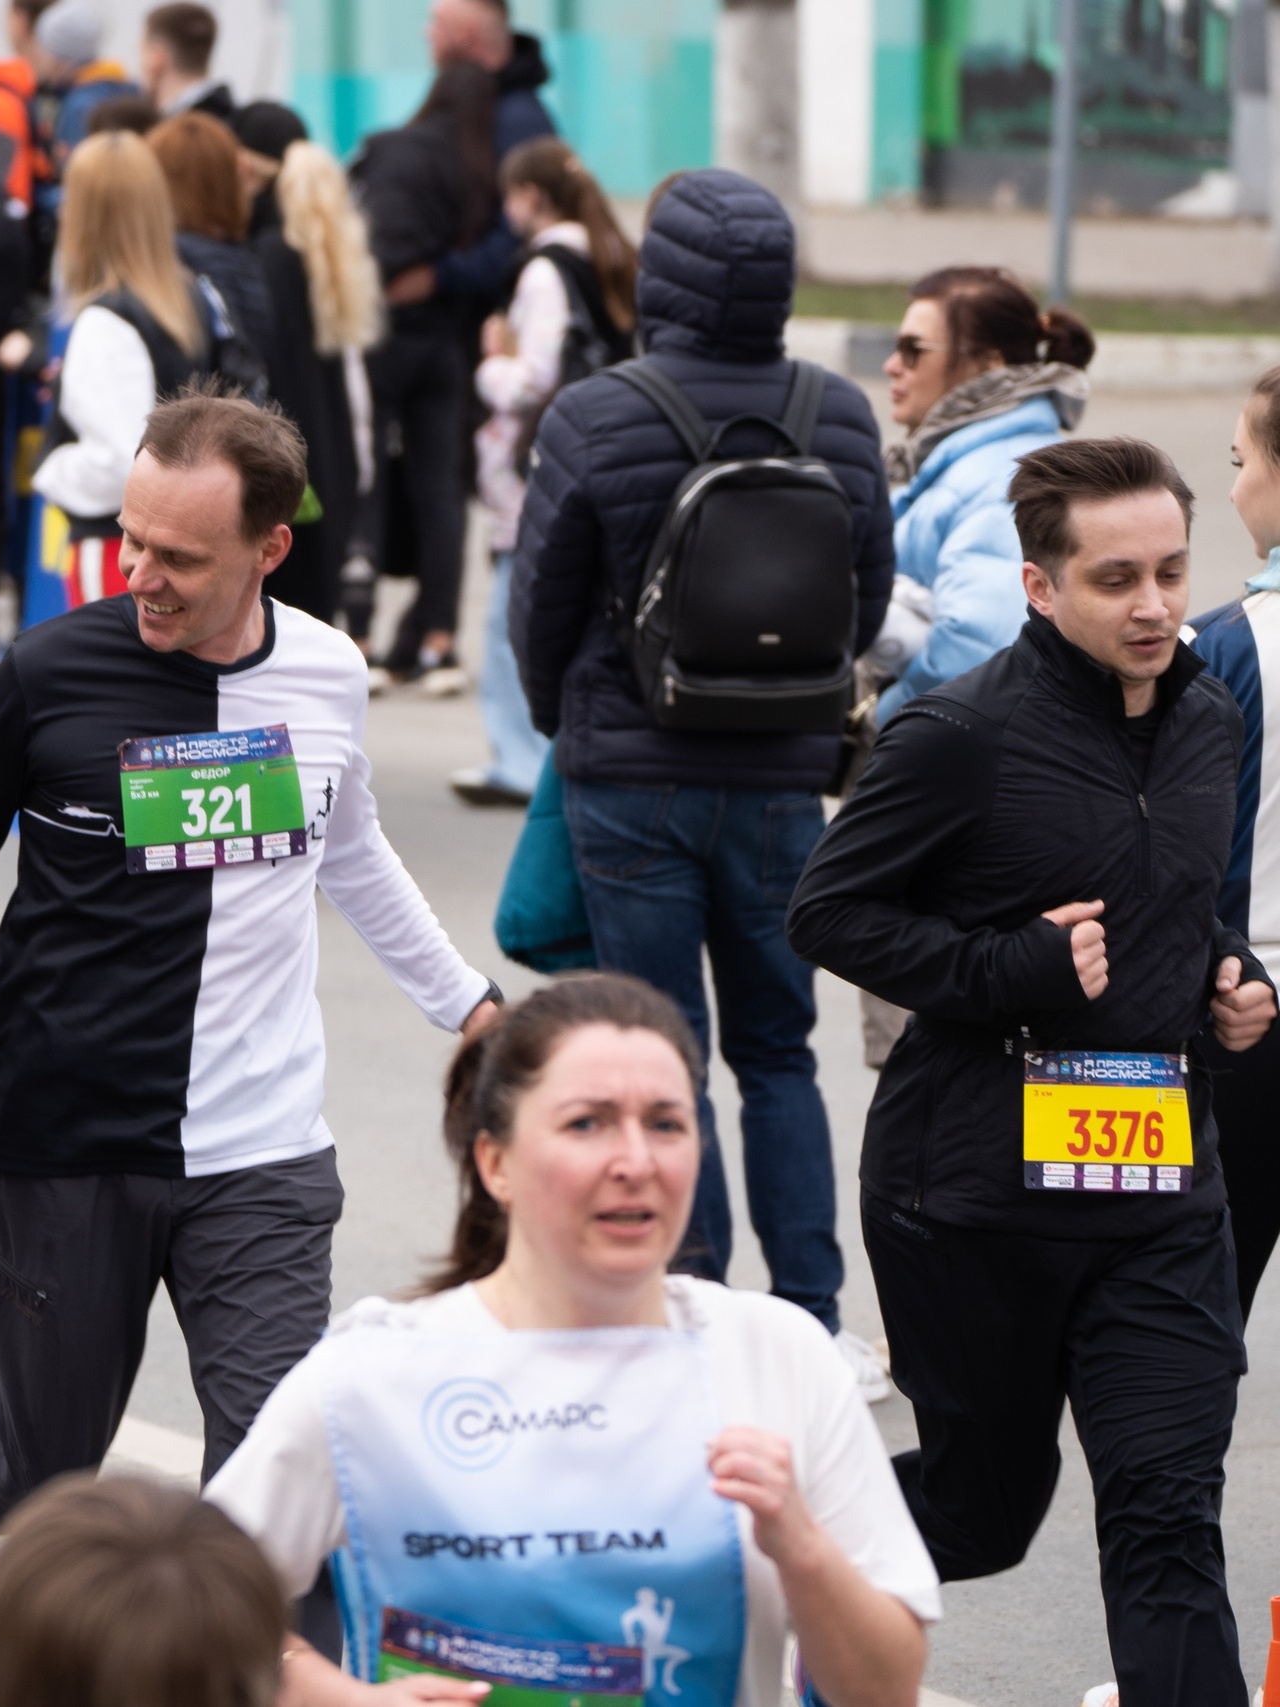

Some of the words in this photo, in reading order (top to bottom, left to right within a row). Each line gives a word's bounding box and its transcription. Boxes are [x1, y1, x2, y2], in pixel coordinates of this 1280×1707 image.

[188, 736, 249, 749] ПРОСТО
[176, 745, 249, 760] КОСМОС
[191, 766, 231, 780] ФЕДОР
[147, 791, 160, 799] км
[180, 783, 253, 837] 321
[1096, 1059, 1152, 1069] ПРОСТО
[1084, 1068, 1151, 1080] КОСМОС
[1066, 1108, 1165, 1159] 3376
[454, 1403, 609, 1441] САМАРС
[403, 1532, 533, 1560] SPORT
[546, 1529, 666, 1555] TEAM
